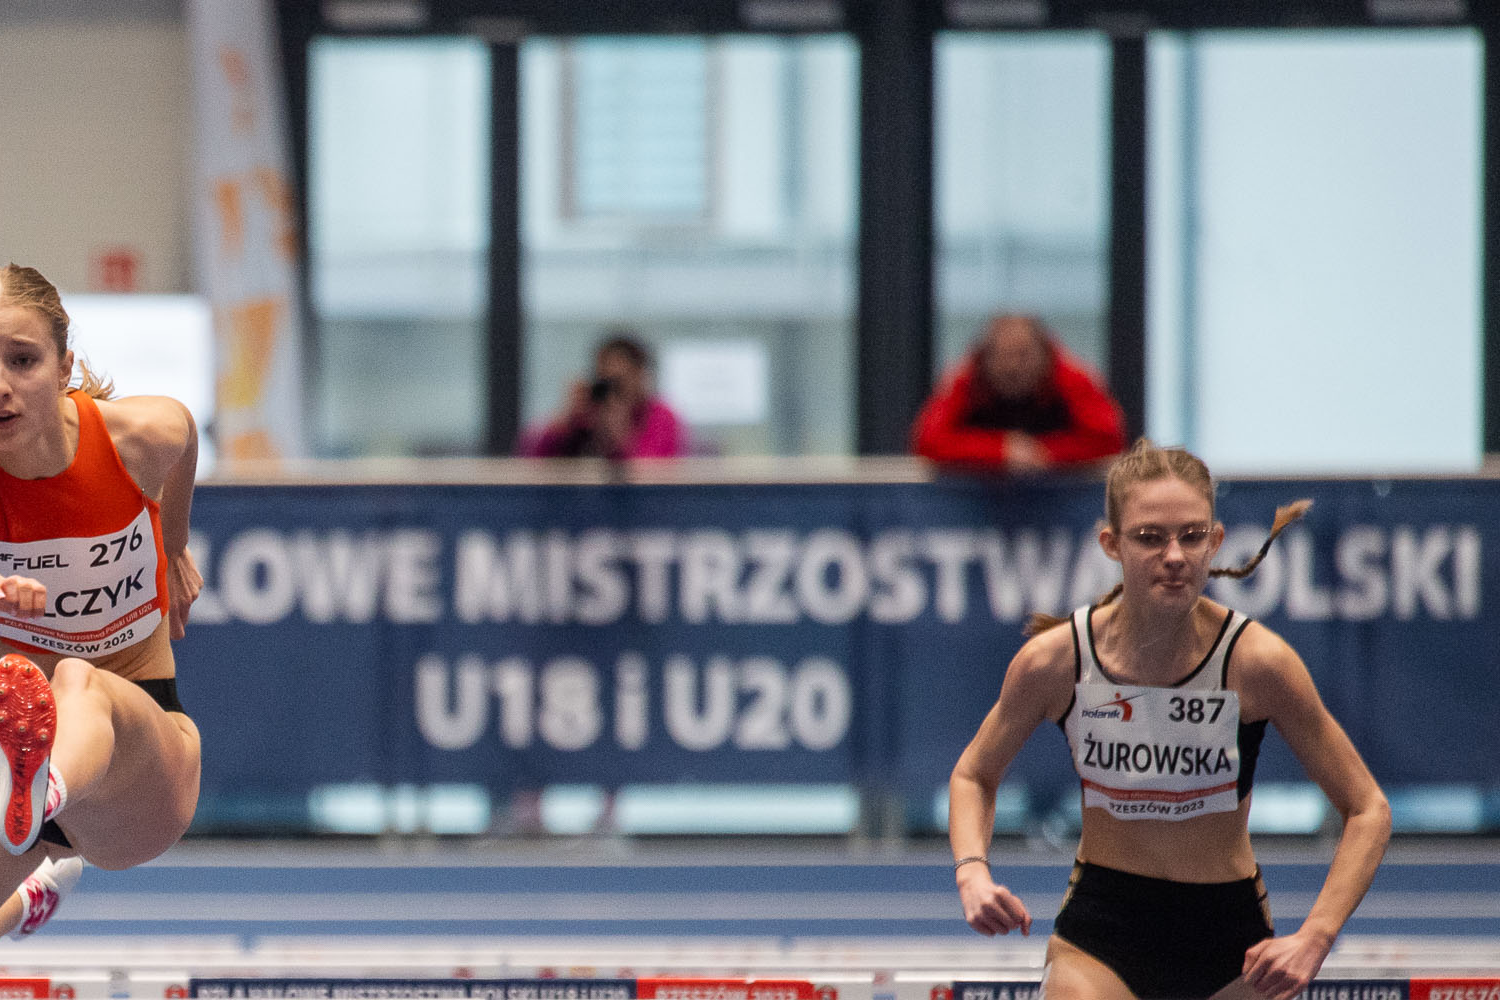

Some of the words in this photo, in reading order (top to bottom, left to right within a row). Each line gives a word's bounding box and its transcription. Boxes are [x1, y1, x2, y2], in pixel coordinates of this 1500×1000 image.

[89, 524, 143, 568] 276
[12, 554, 70, 571] FUEL
[188, 528, 441, 624] LOWE
[1208, 526, 1482, 622] OLSKI
[31, 635, 101, 654] RZESZÓW
[103, 628, 135, 650] 2023
[413, 651, 601, 752] U18
[613, 650, 650, 752] i
[662, 651, 854, 752] U20
[1082, 708, 1121, 719] polanik
[1168, 696, 1226, 724] 387
[1083, 732, 1232, 776] ŻUROWSKA
[1173, 800, 1205, 816] 2023
